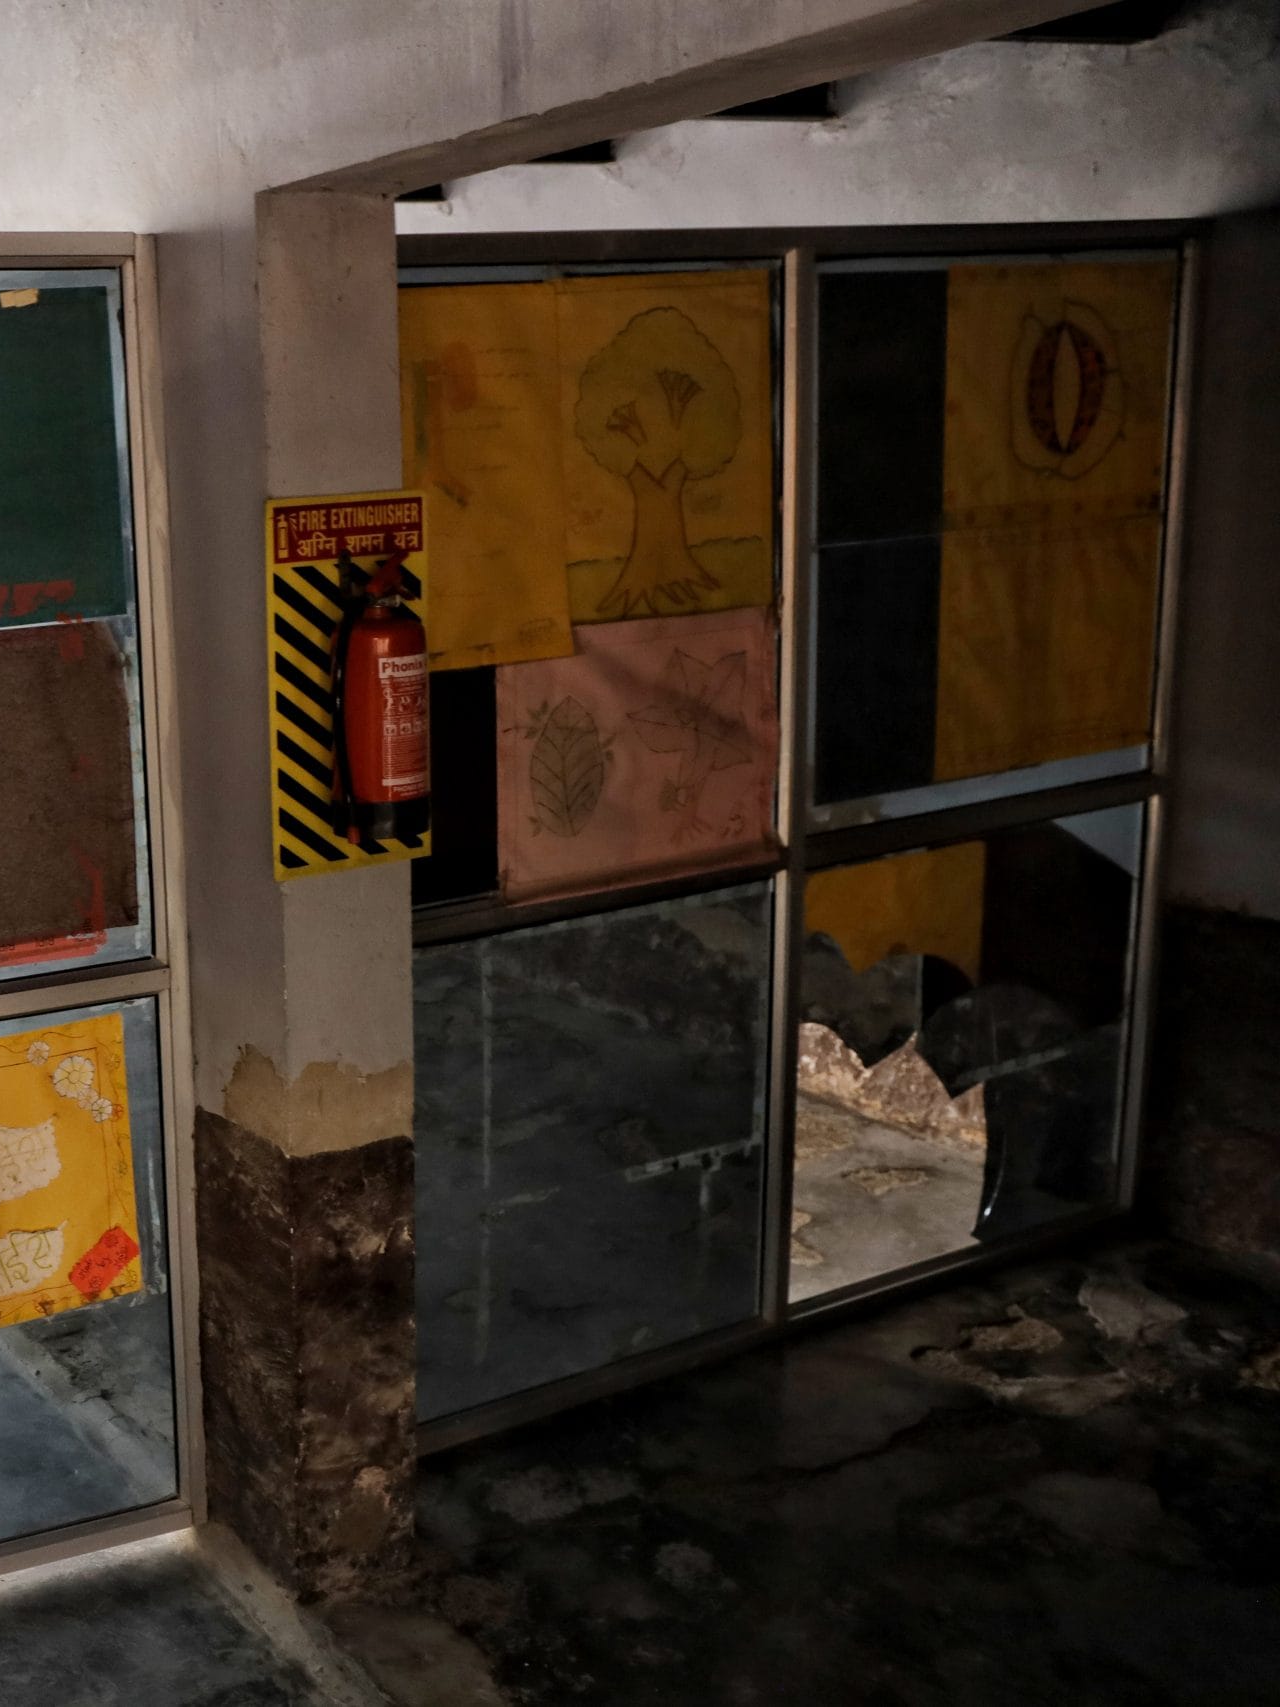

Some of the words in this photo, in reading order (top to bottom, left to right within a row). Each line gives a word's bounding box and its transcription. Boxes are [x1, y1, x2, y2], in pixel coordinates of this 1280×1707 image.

[298, 509, 328, 532] FIRE
[330, 502, 420, 529] EXTINGUISHER
[296, 531, 337, 558] अग्नि
[344, 533, 385, 553] शमन
[393, 526, 420, 549] यंत्र
